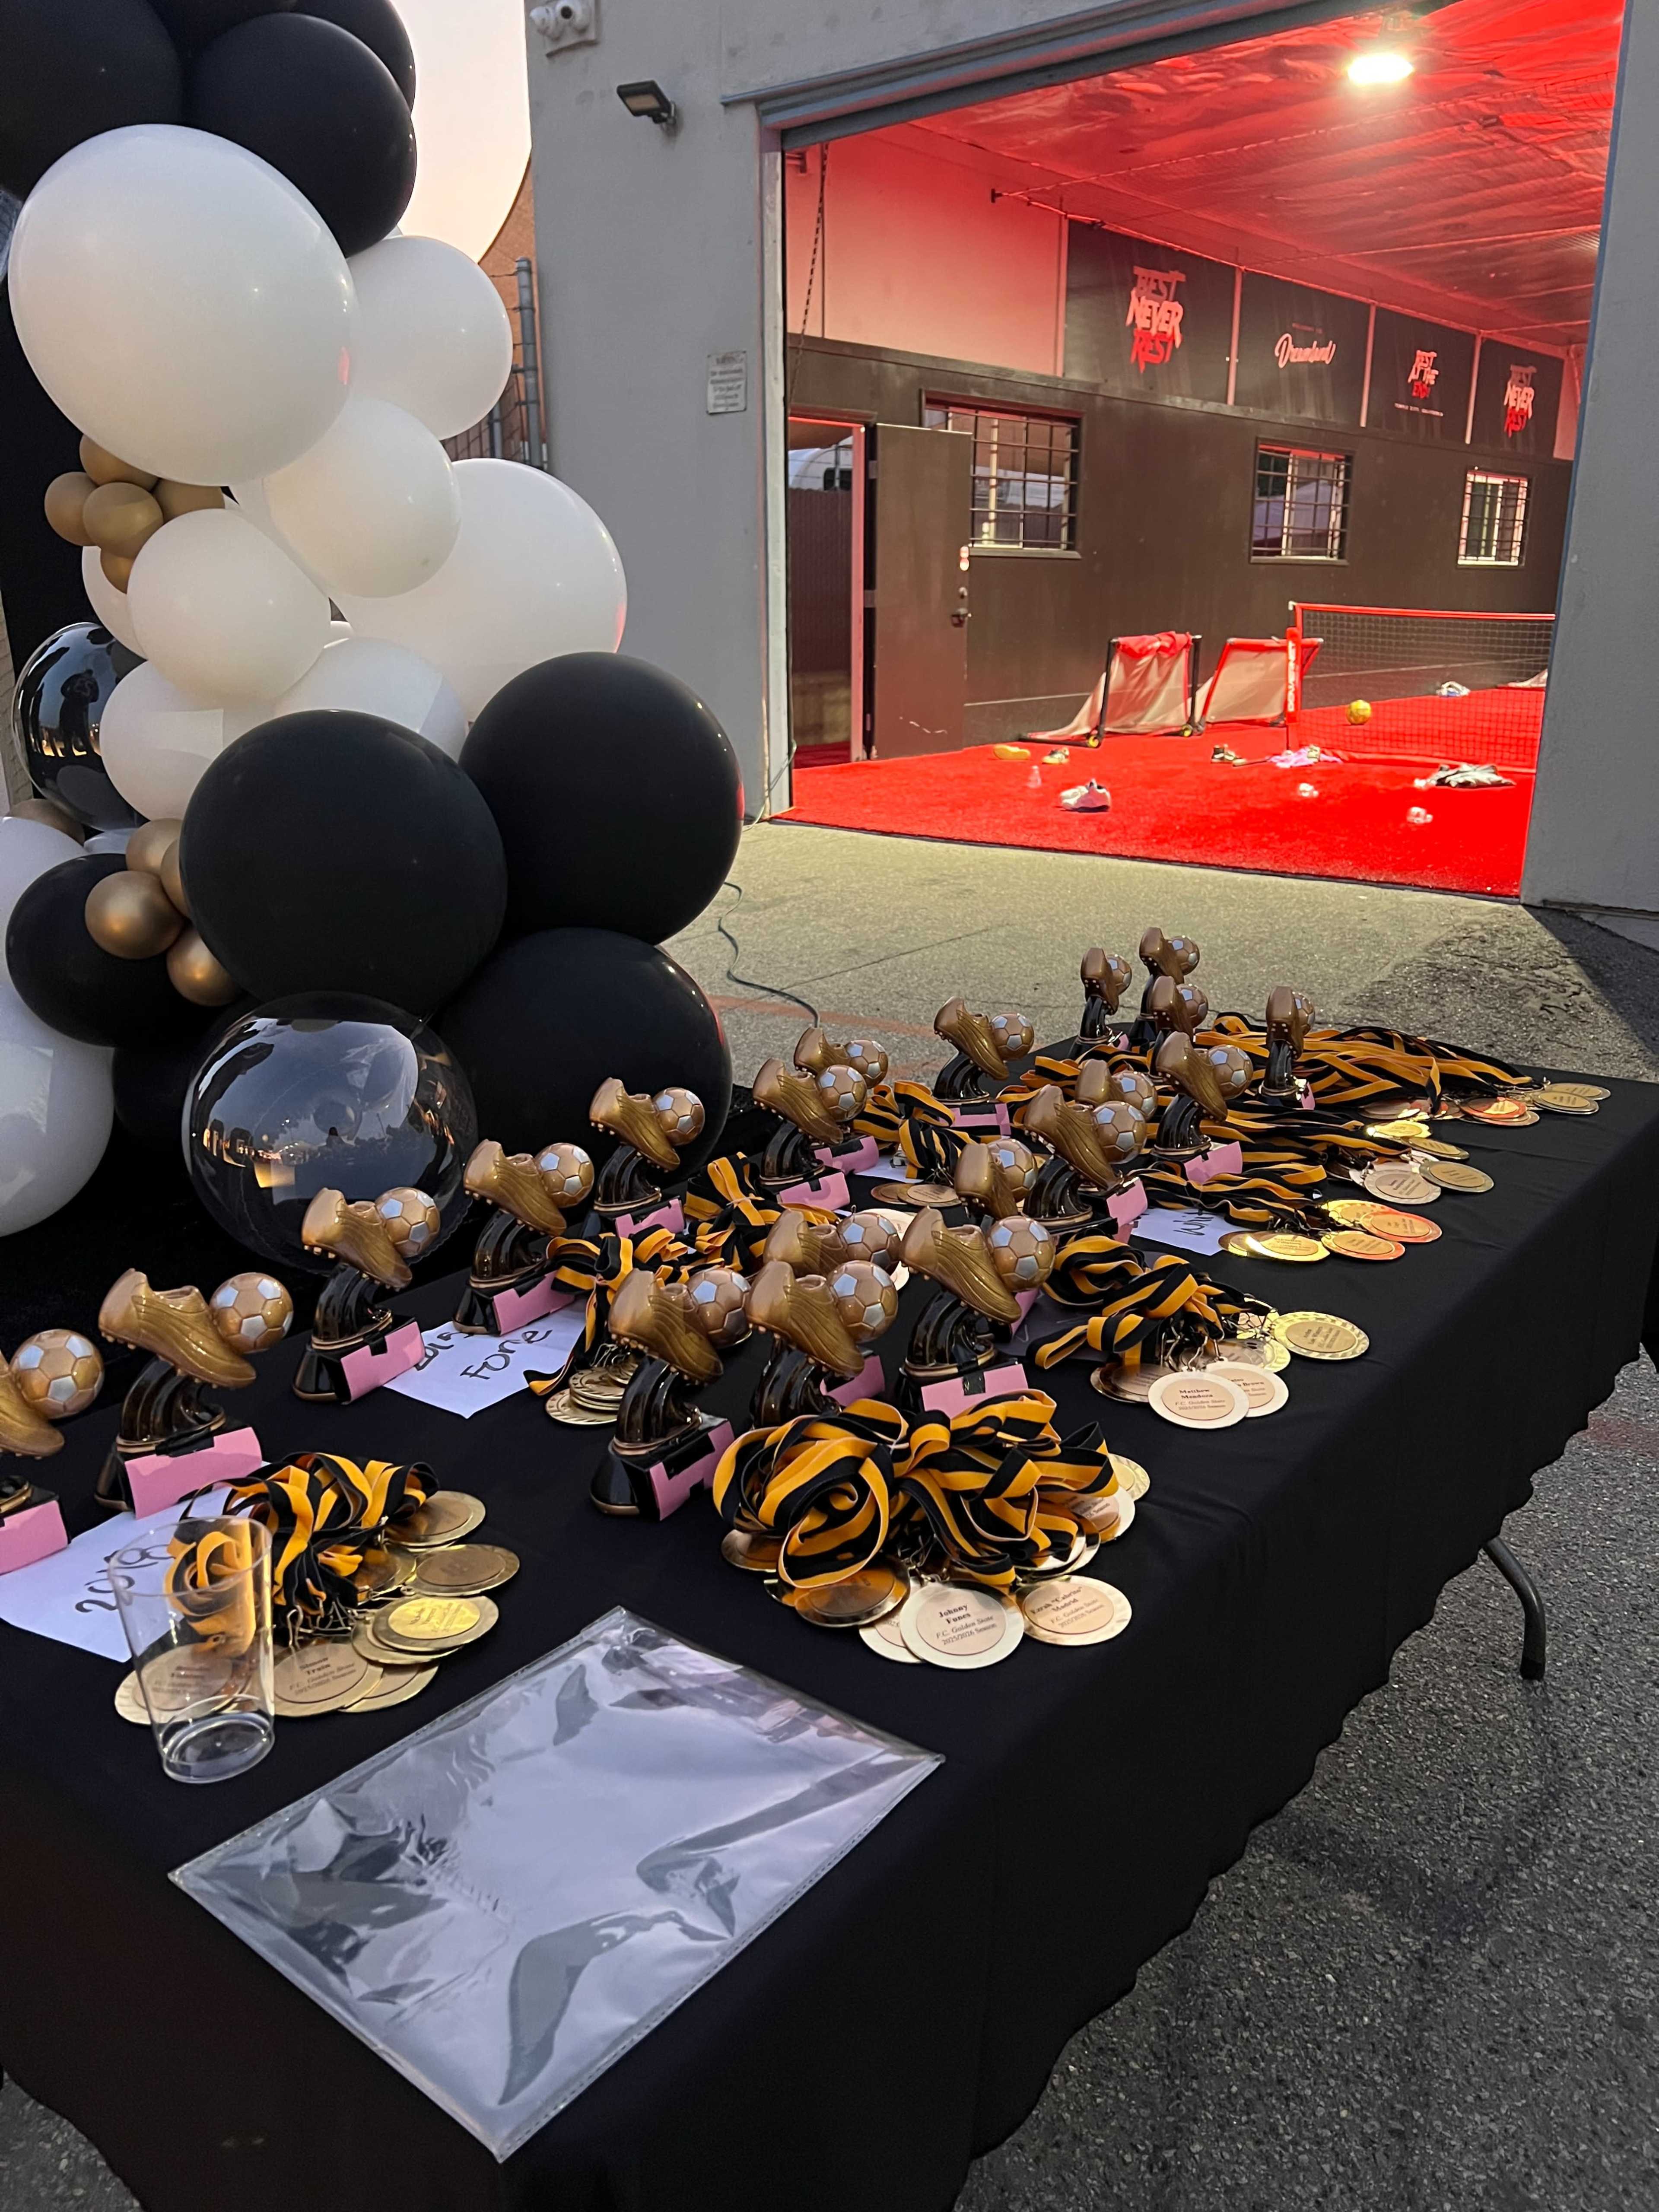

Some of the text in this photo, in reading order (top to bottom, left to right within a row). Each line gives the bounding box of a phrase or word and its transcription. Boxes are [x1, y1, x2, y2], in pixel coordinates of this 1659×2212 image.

[1126, 287, 1183, 348] NEVER
[1130, 328, 1182, 374] REST
[939, 1604, 968, 1618] Johnny
[951, 1622, 976, 1634] Golden
